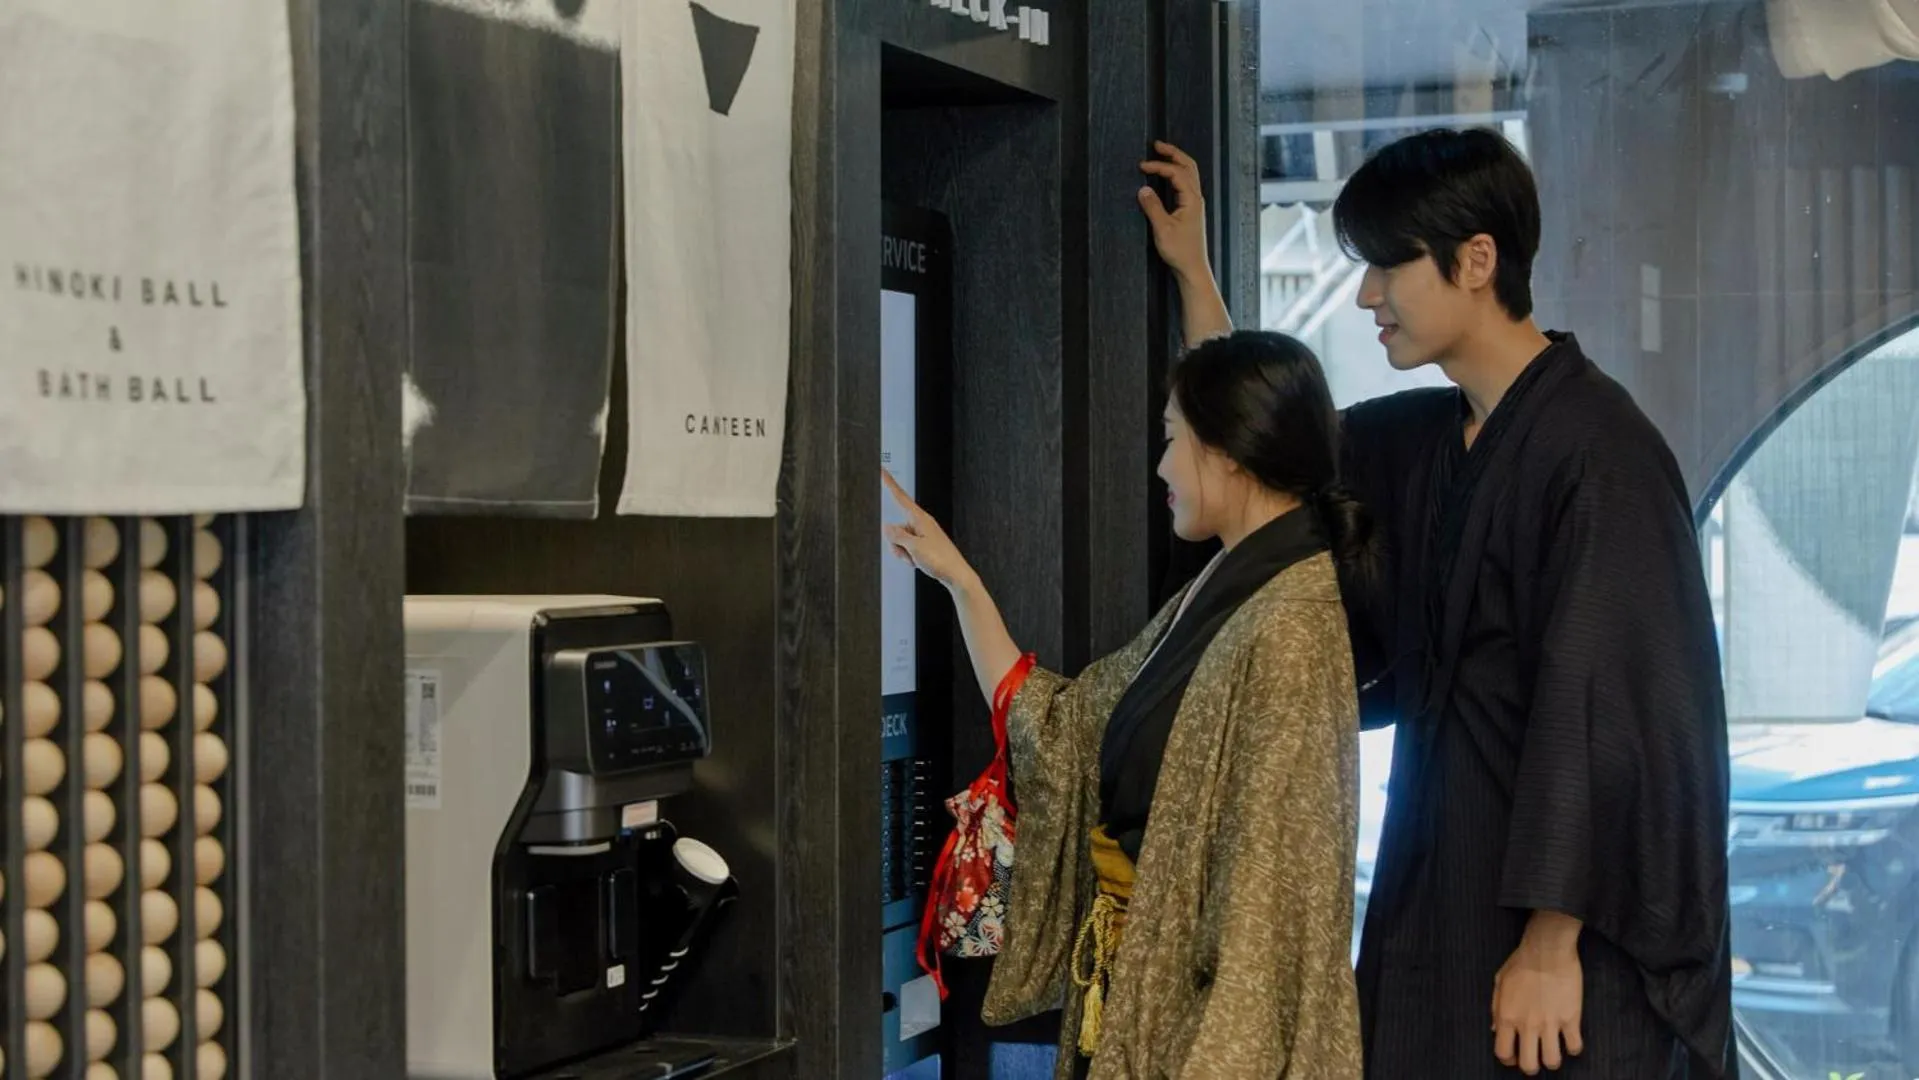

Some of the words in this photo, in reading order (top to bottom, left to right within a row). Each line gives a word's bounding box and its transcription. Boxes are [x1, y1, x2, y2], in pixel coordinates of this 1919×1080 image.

[15, 263, 122, 301] HINOKI
[141, 277, 227, 307] BALL
[109, 325, 122, 352] &
[38, 368, 110, 400] BATH
[128, 376, 216, 402] BALL
[685, 414, 765, 437] CANTEEN
